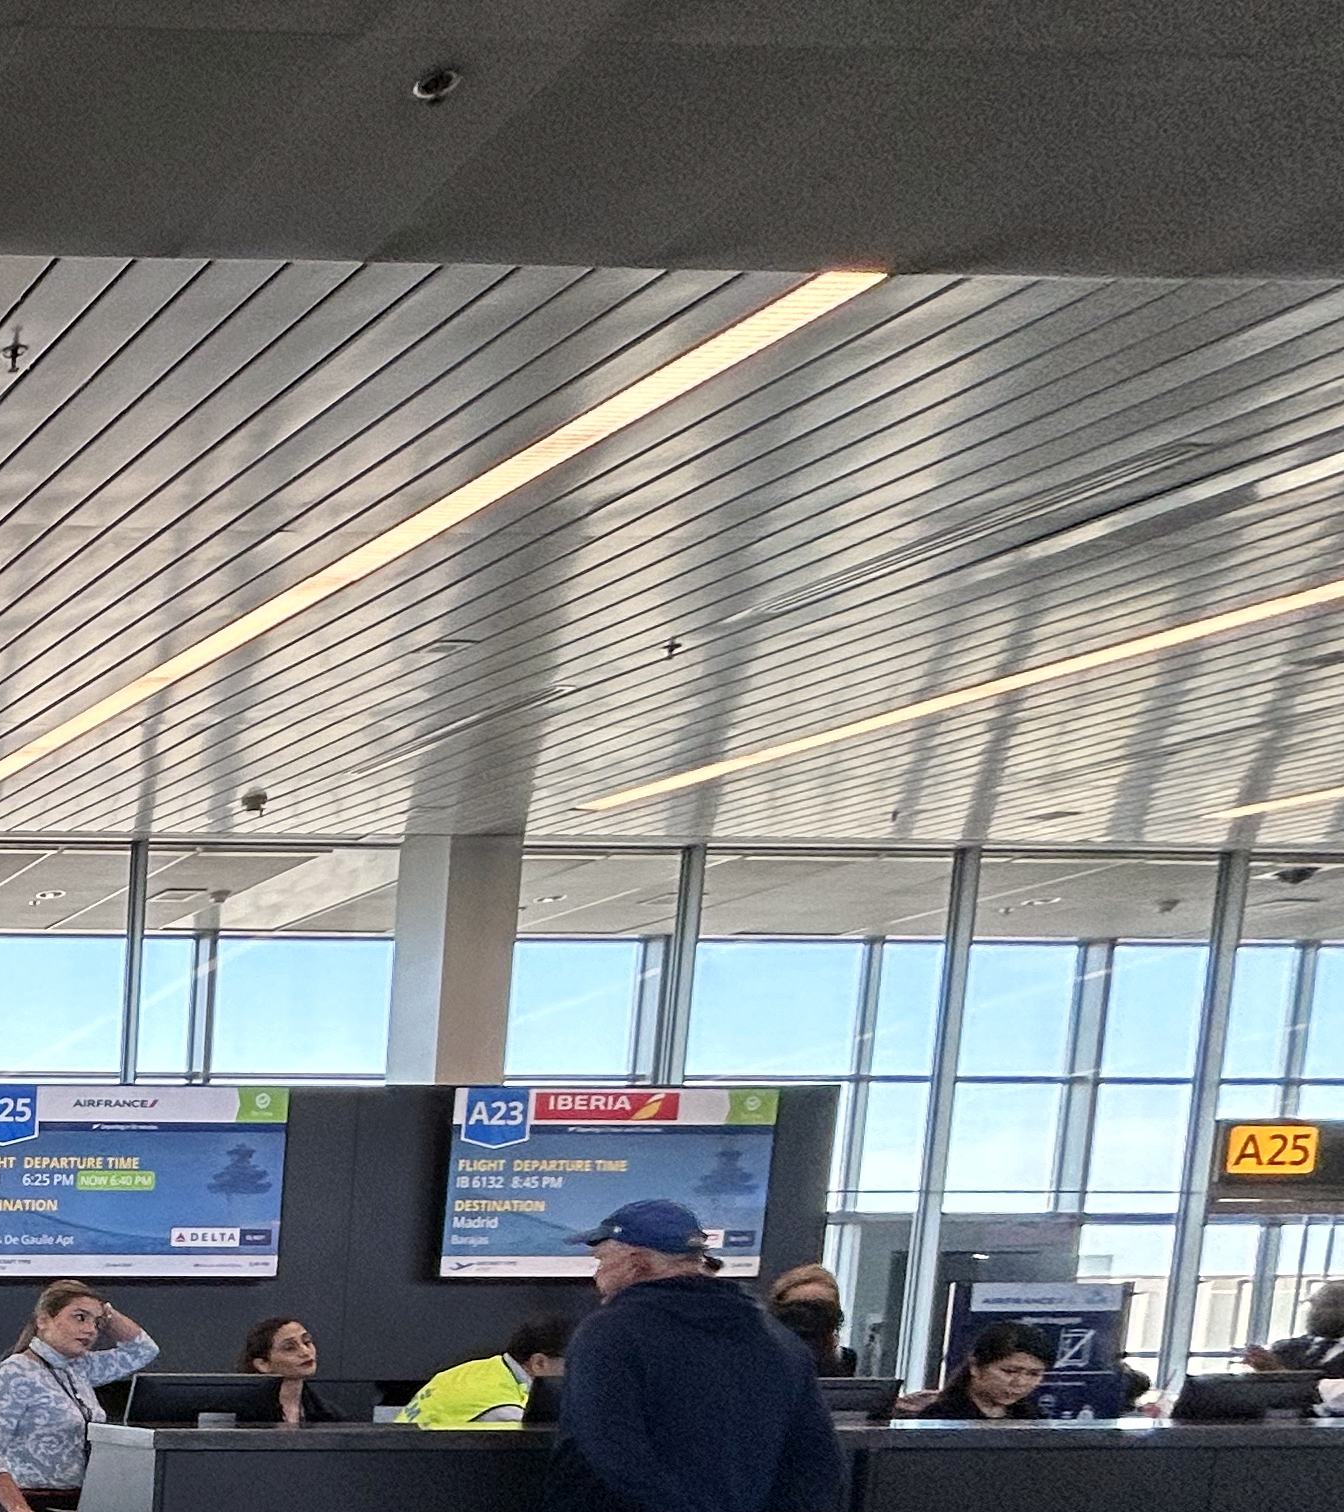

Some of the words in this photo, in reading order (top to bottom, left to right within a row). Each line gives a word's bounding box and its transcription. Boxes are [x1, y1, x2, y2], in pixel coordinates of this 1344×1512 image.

[73, 1098, 148, 1108] AIRFRANCE
[548, 1095, 631, 1111] IBERIA
[468, 1101, 524, 1126] A23
[1232, 1133, 1312, 1167] A25
[23, 1156, 103, 1169] DEPARTURE
[107, 1156, 139, 1169] TIME
[457, 1159, 506, 1171] FLIGHT
[514, 1159, 591, 1171] DEPARTURE
[596, 1159, 628, 1171] TIME
[22, 1173, 50, 1186] 6:25
[53, 1173, 74, 1186] PM
[80, 1175, 108, 1186] NOW
[134, 1175, 152, 1186] PM
[456, 1176, 470, 1189] IB
[472, 1176, 504, 1189] 6132
[512, 1176, 539, 1189] 8:45
[542, 1176, 563, 1189] PM
[454, 1200, 546, 1212] DESTINATION
[452, 1216, 499, 1228] Madrid
[4, 1235, 19, 1245] De
[55, 1235, 74, 1247] Apt
[190, 1232, 236, 1242] DELTA
